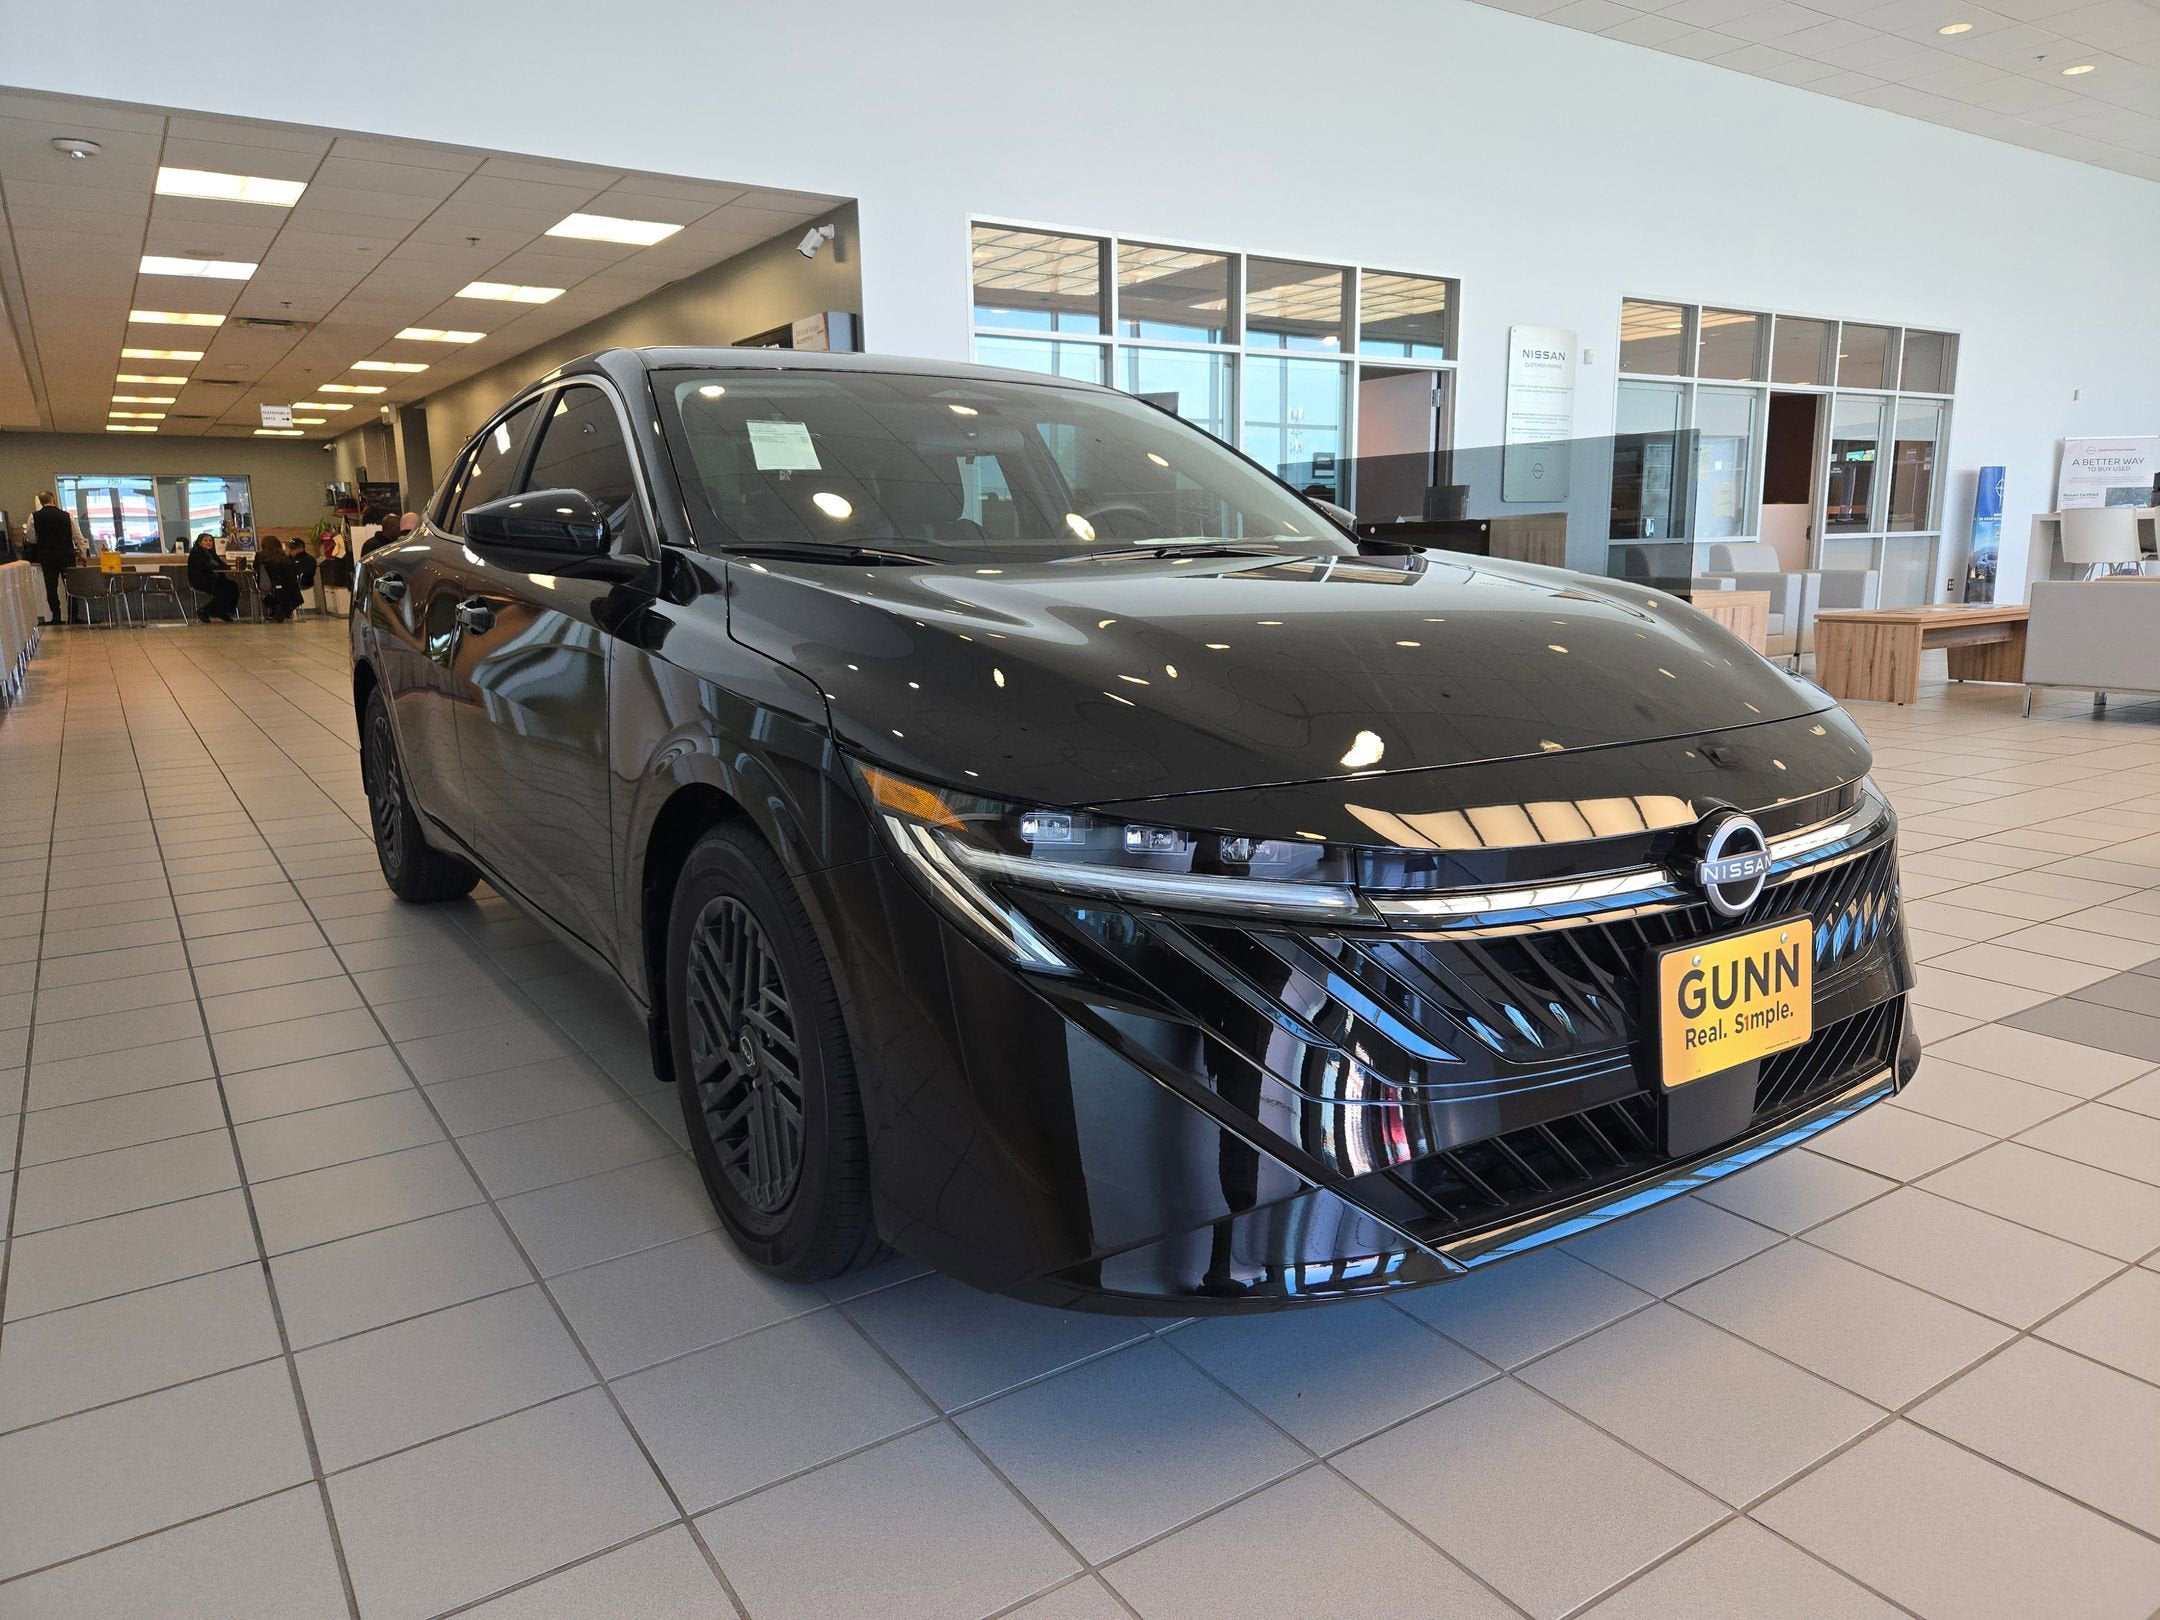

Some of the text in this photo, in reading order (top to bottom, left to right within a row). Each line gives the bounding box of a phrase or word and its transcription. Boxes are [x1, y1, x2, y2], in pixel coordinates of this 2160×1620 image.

[1522, 349, 1566, 361] NISSAN
[2072, 457, 2145, 466] A BETTER WAY
[1703, 855, 1772, 882] NISSAN
[1678, 943, 1799, 1019] GUNN
[1685, 1018, 1727, 1050] Real.
